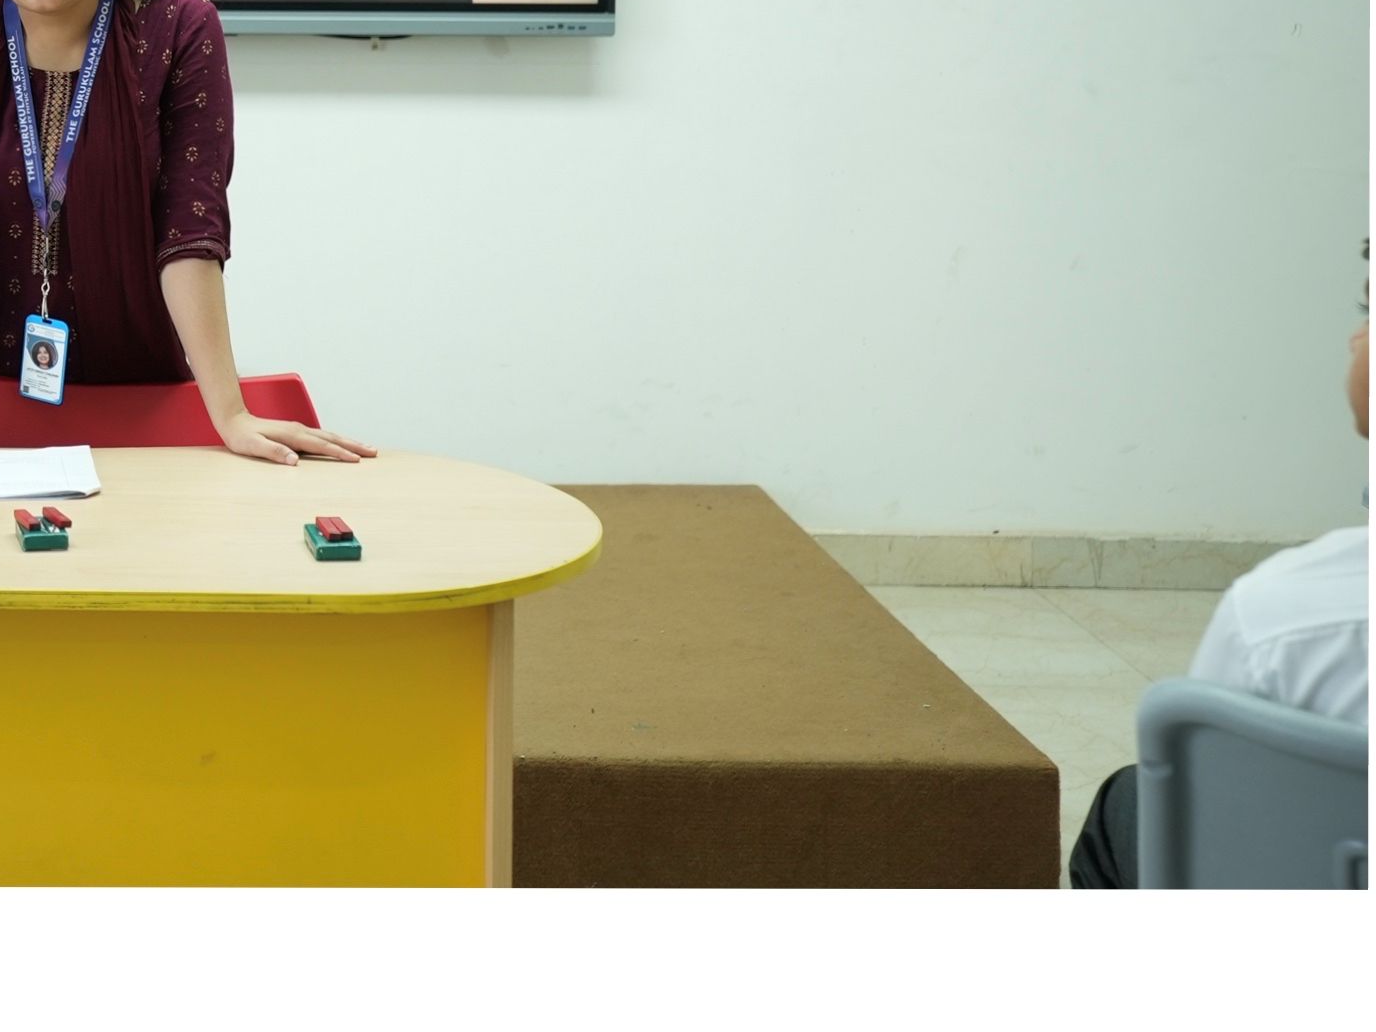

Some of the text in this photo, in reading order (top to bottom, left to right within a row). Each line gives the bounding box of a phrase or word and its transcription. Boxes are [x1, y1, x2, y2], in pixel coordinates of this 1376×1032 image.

[8, 35, 36, 183] THE GURUKULAM SCHOOL
[66, 1, 111, 143] THE GURUKULAM SCHOOL
